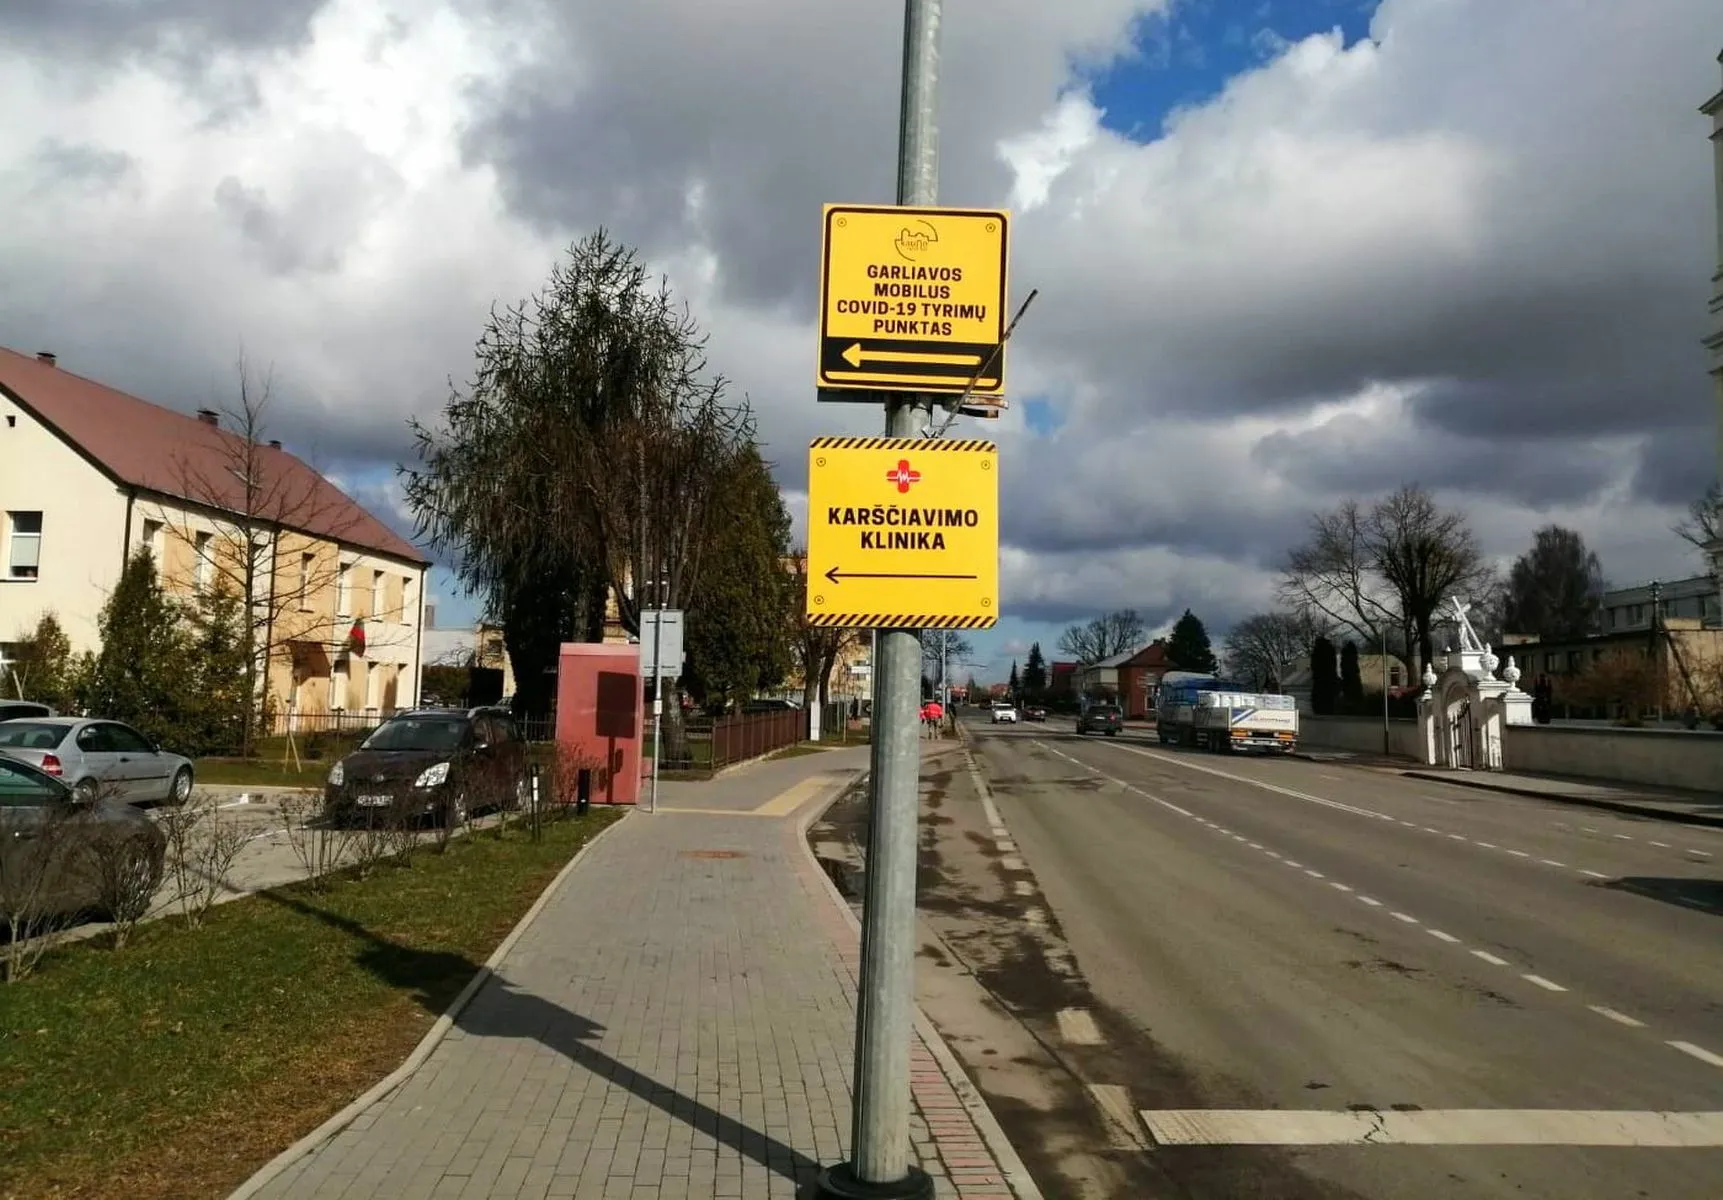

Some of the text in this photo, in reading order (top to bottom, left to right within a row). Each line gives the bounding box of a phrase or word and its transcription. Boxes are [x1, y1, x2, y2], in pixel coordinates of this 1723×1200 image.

[867, 264, 962, 281] GARLIAVOS
[874, 283, 950, 299] MOBILUS
[837, 300, 986, 322] COVID-19 TYRIMŲ
[873, 319, 952, 336] PUNKTAS
[828, 504, 978, 527] KARŠČIAVIMO
[861, 531, 945, 550] KLINIKA
